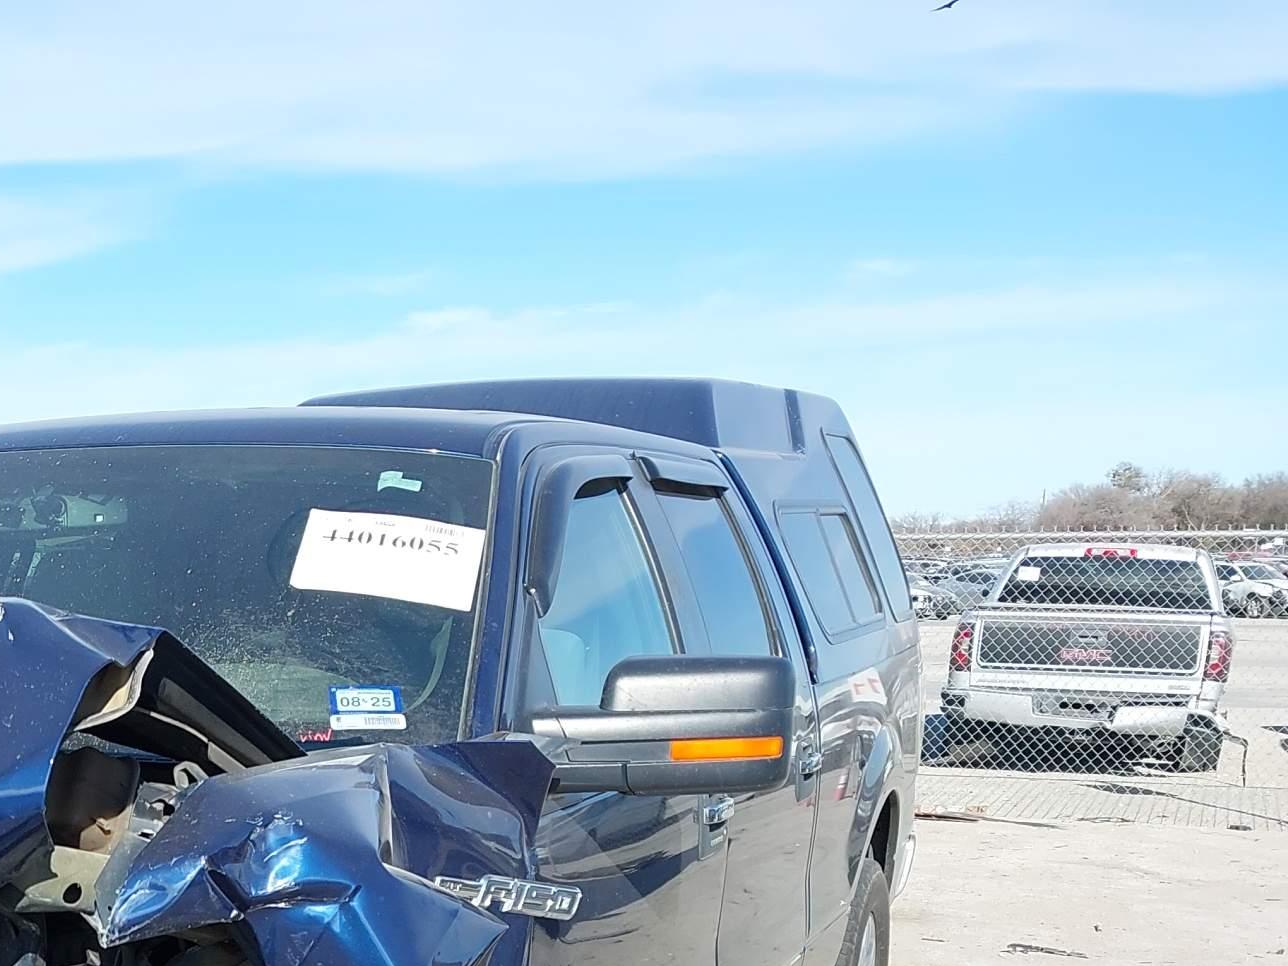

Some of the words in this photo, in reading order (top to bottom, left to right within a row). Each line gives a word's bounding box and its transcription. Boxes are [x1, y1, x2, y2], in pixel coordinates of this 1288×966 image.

[322, 529, 460, 556] 44016055
[1060, 648, 1113, 661] GMC
[339, 696, 361, 708] 08
[371, 696, 392, 708] 25
